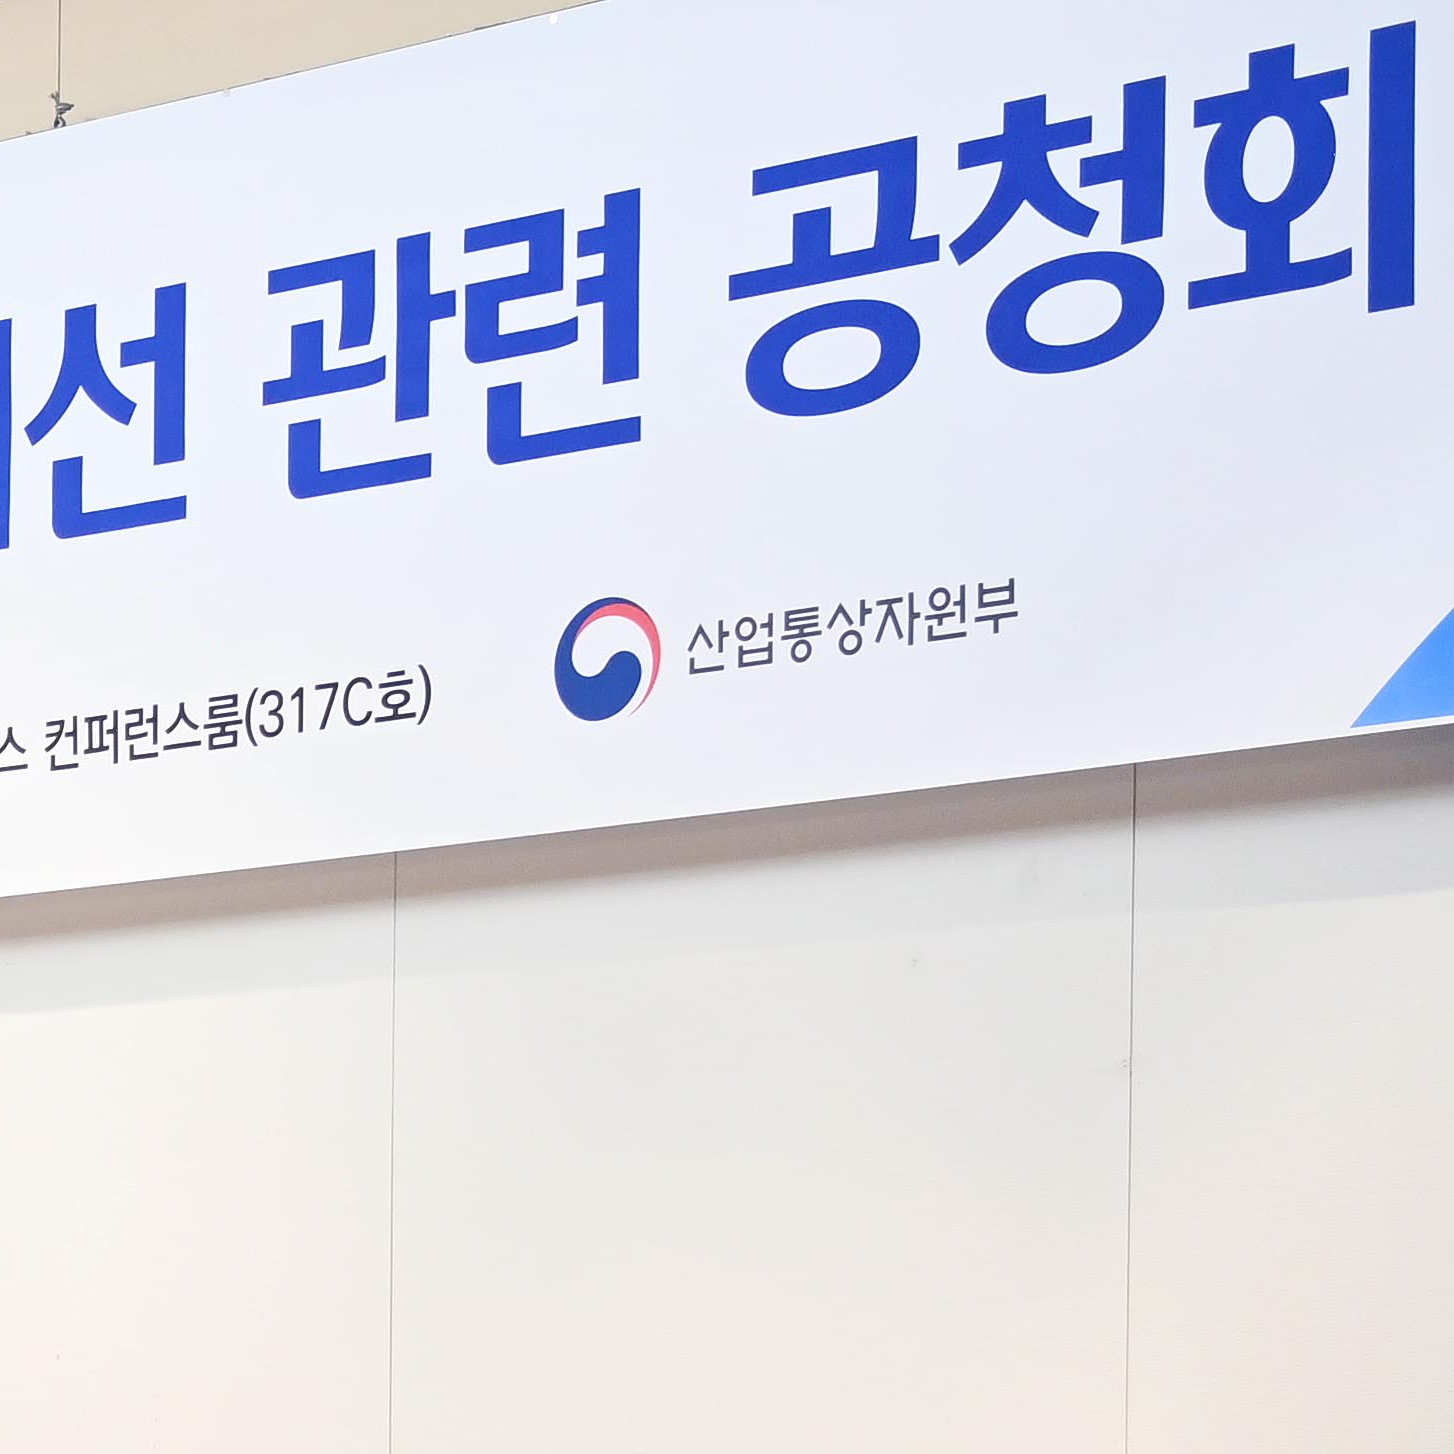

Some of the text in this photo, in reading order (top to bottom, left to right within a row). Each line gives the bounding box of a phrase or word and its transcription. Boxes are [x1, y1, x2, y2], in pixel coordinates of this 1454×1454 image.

[262, 187, 642, 500] 관련
[728, 19, 1417, 417] 공청회
[687, 577, 1019, 675] 산업통상자원부
[44, 664, 432, 772] 컨퍼런스룸(317C호)
